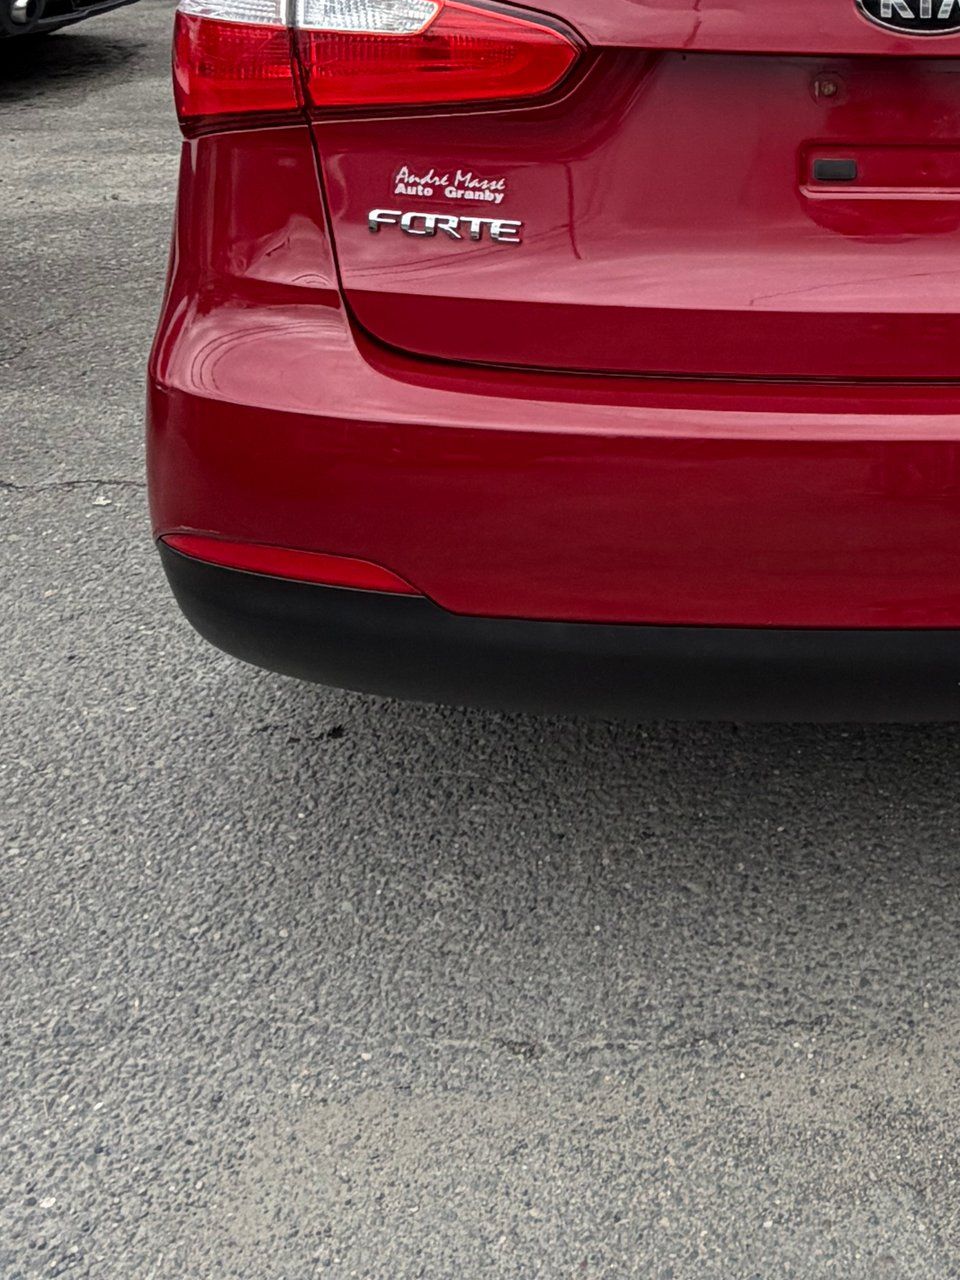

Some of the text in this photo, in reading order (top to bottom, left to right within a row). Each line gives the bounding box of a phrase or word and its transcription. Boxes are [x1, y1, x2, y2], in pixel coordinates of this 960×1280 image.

[394, 182, 505, 204] Auto Granby
[368, 209, 522, 243] FORTE
